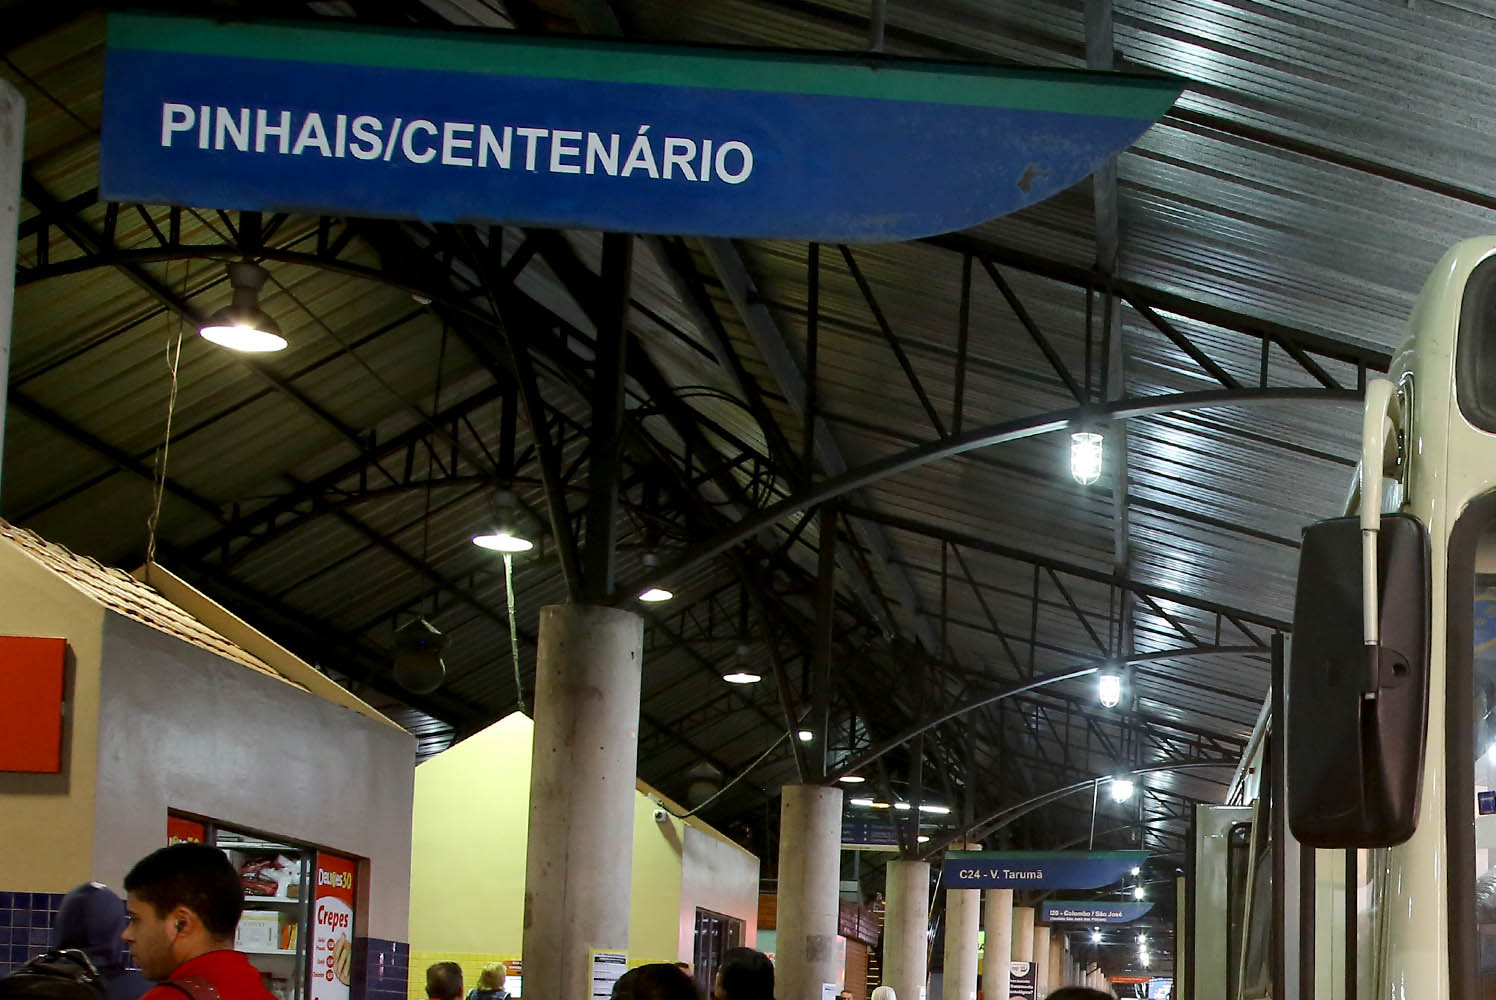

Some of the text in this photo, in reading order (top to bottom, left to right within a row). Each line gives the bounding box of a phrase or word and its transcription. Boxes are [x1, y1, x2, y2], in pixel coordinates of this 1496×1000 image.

[161, 102, 754, 185] PINHAIS/CENTENÁRIO
[959, 869, 980, 880] C24
[990, 869, 1000, 880] V.
[1003, 869, 1043, 880] Tarumã
[317, 905, 349, 932] Crepes
[1063, 909, 1090, 917] Colombo
